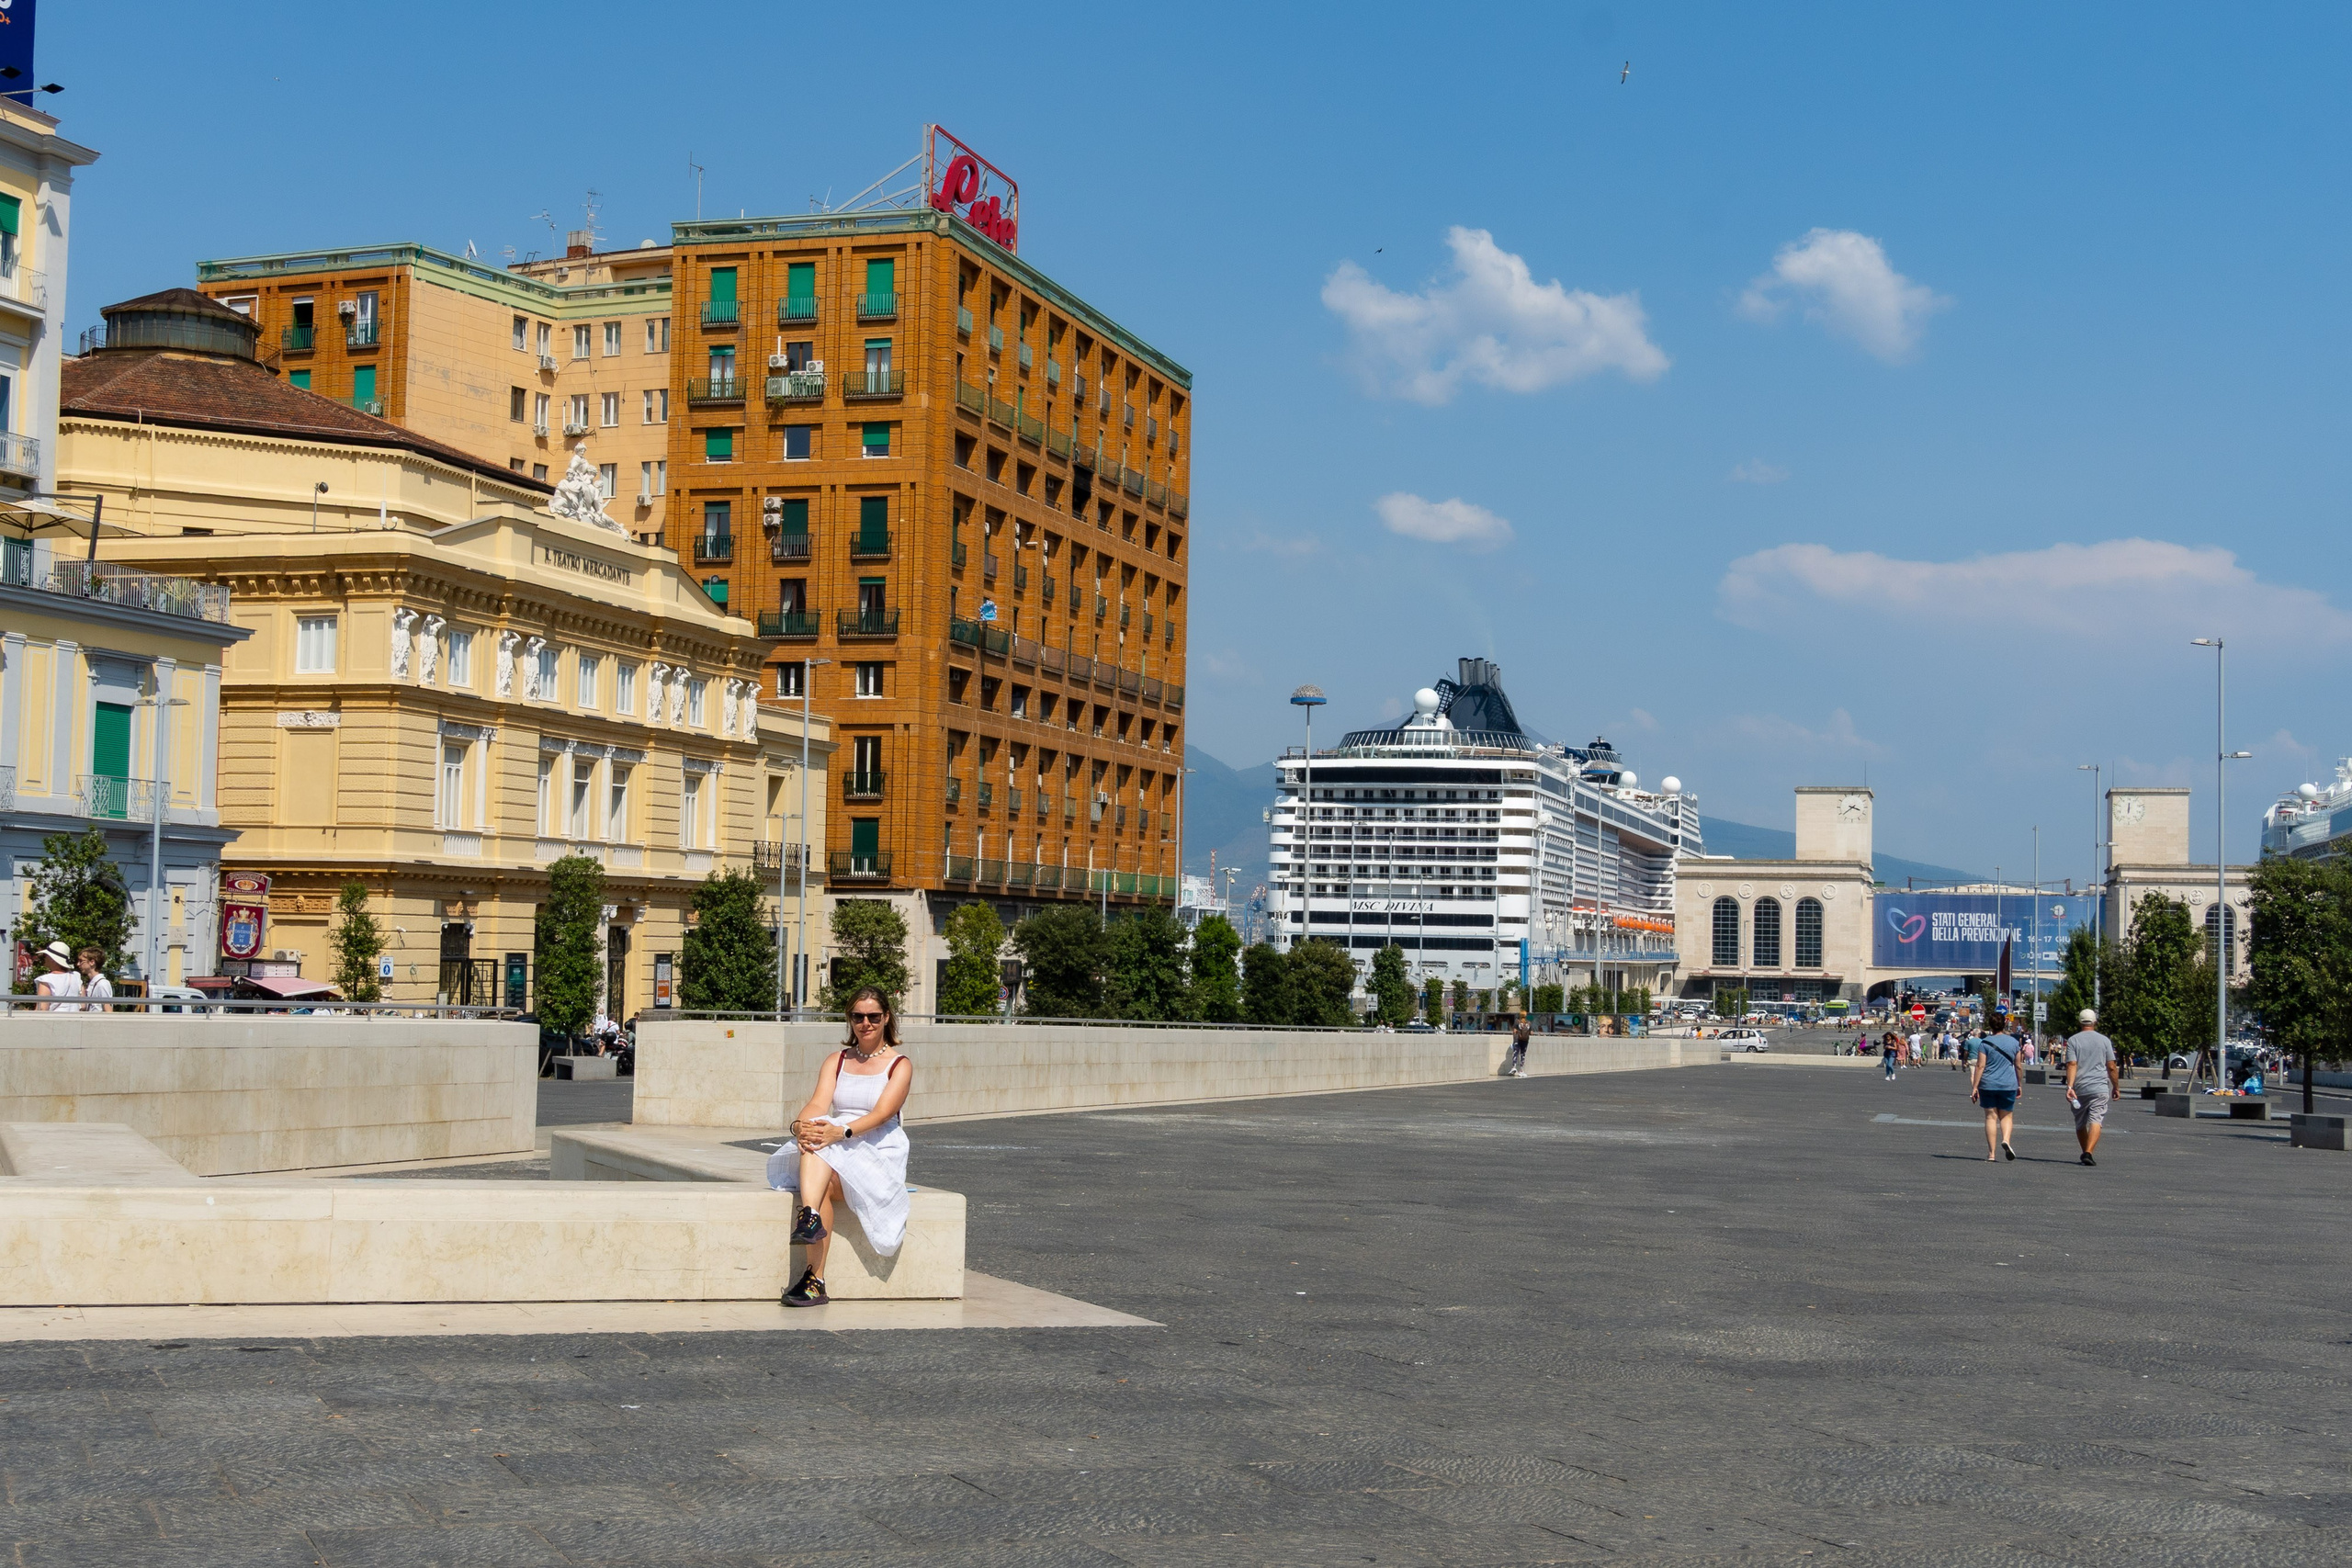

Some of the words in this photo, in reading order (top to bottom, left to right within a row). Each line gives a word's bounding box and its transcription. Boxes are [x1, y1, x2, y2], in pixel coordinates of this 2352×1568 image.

[553, 549, 581, 570] TEATRO
[582, 558, 631, 585] MERCADANTE
[1352, 901, 1380, 910] MSC
[1385, 902, 1434, 911] DIVINA
[1932, 912, 1955, 927] STATI
[1958, 913, 2001, 928] GENERAL
[1932, 927, 1959, 942] DELLA
[1962, 928, 2022, 942] PREVENZIONE
